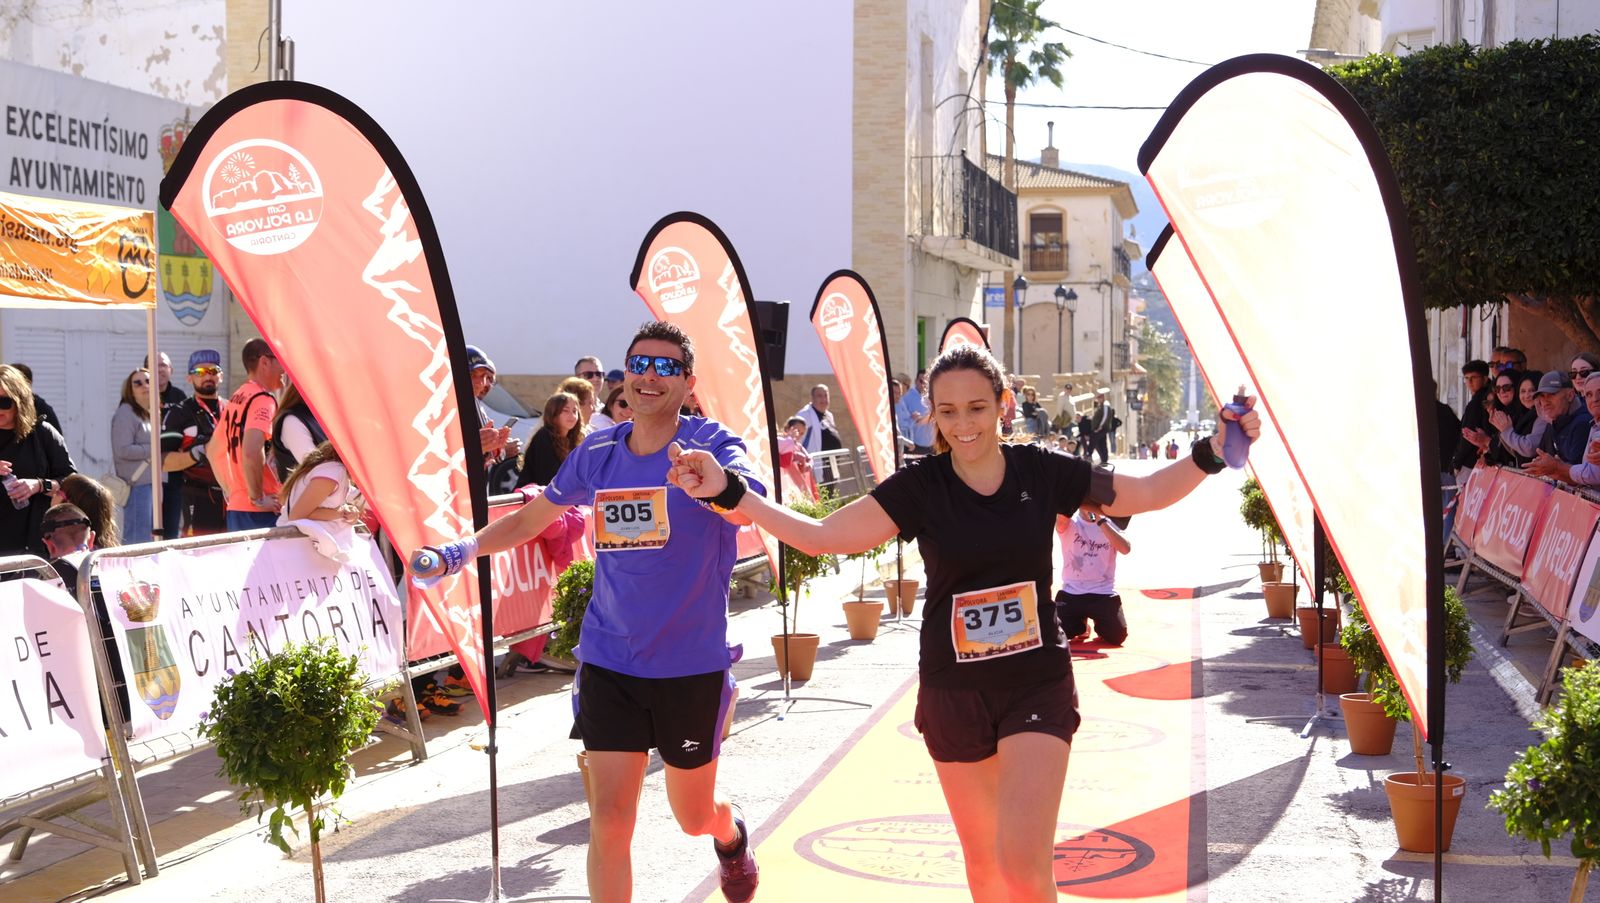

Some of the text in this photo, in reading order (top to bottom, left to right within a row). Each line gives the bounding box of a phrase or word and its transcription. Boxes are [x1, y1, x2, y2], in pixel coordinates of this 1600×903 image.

[6, 104, 149, 161] EXCELENTÍSIMO
[9, 157, 146, 205] AYUNTAMIENTO
[605, 503, 653, 524] 305
[1495, 504, 1533, 551] VEOLIA
[1544, 527, 1584, 585] VEOLIA
[181, 569, 378, 619] AYUNTAMIENTO DE
[964, 600, 1022, 630] 375
[14, 630, 52, 663] DE
[188, 597, 389, 677] CANTORIA
[0, 671, 75, 738] IA
